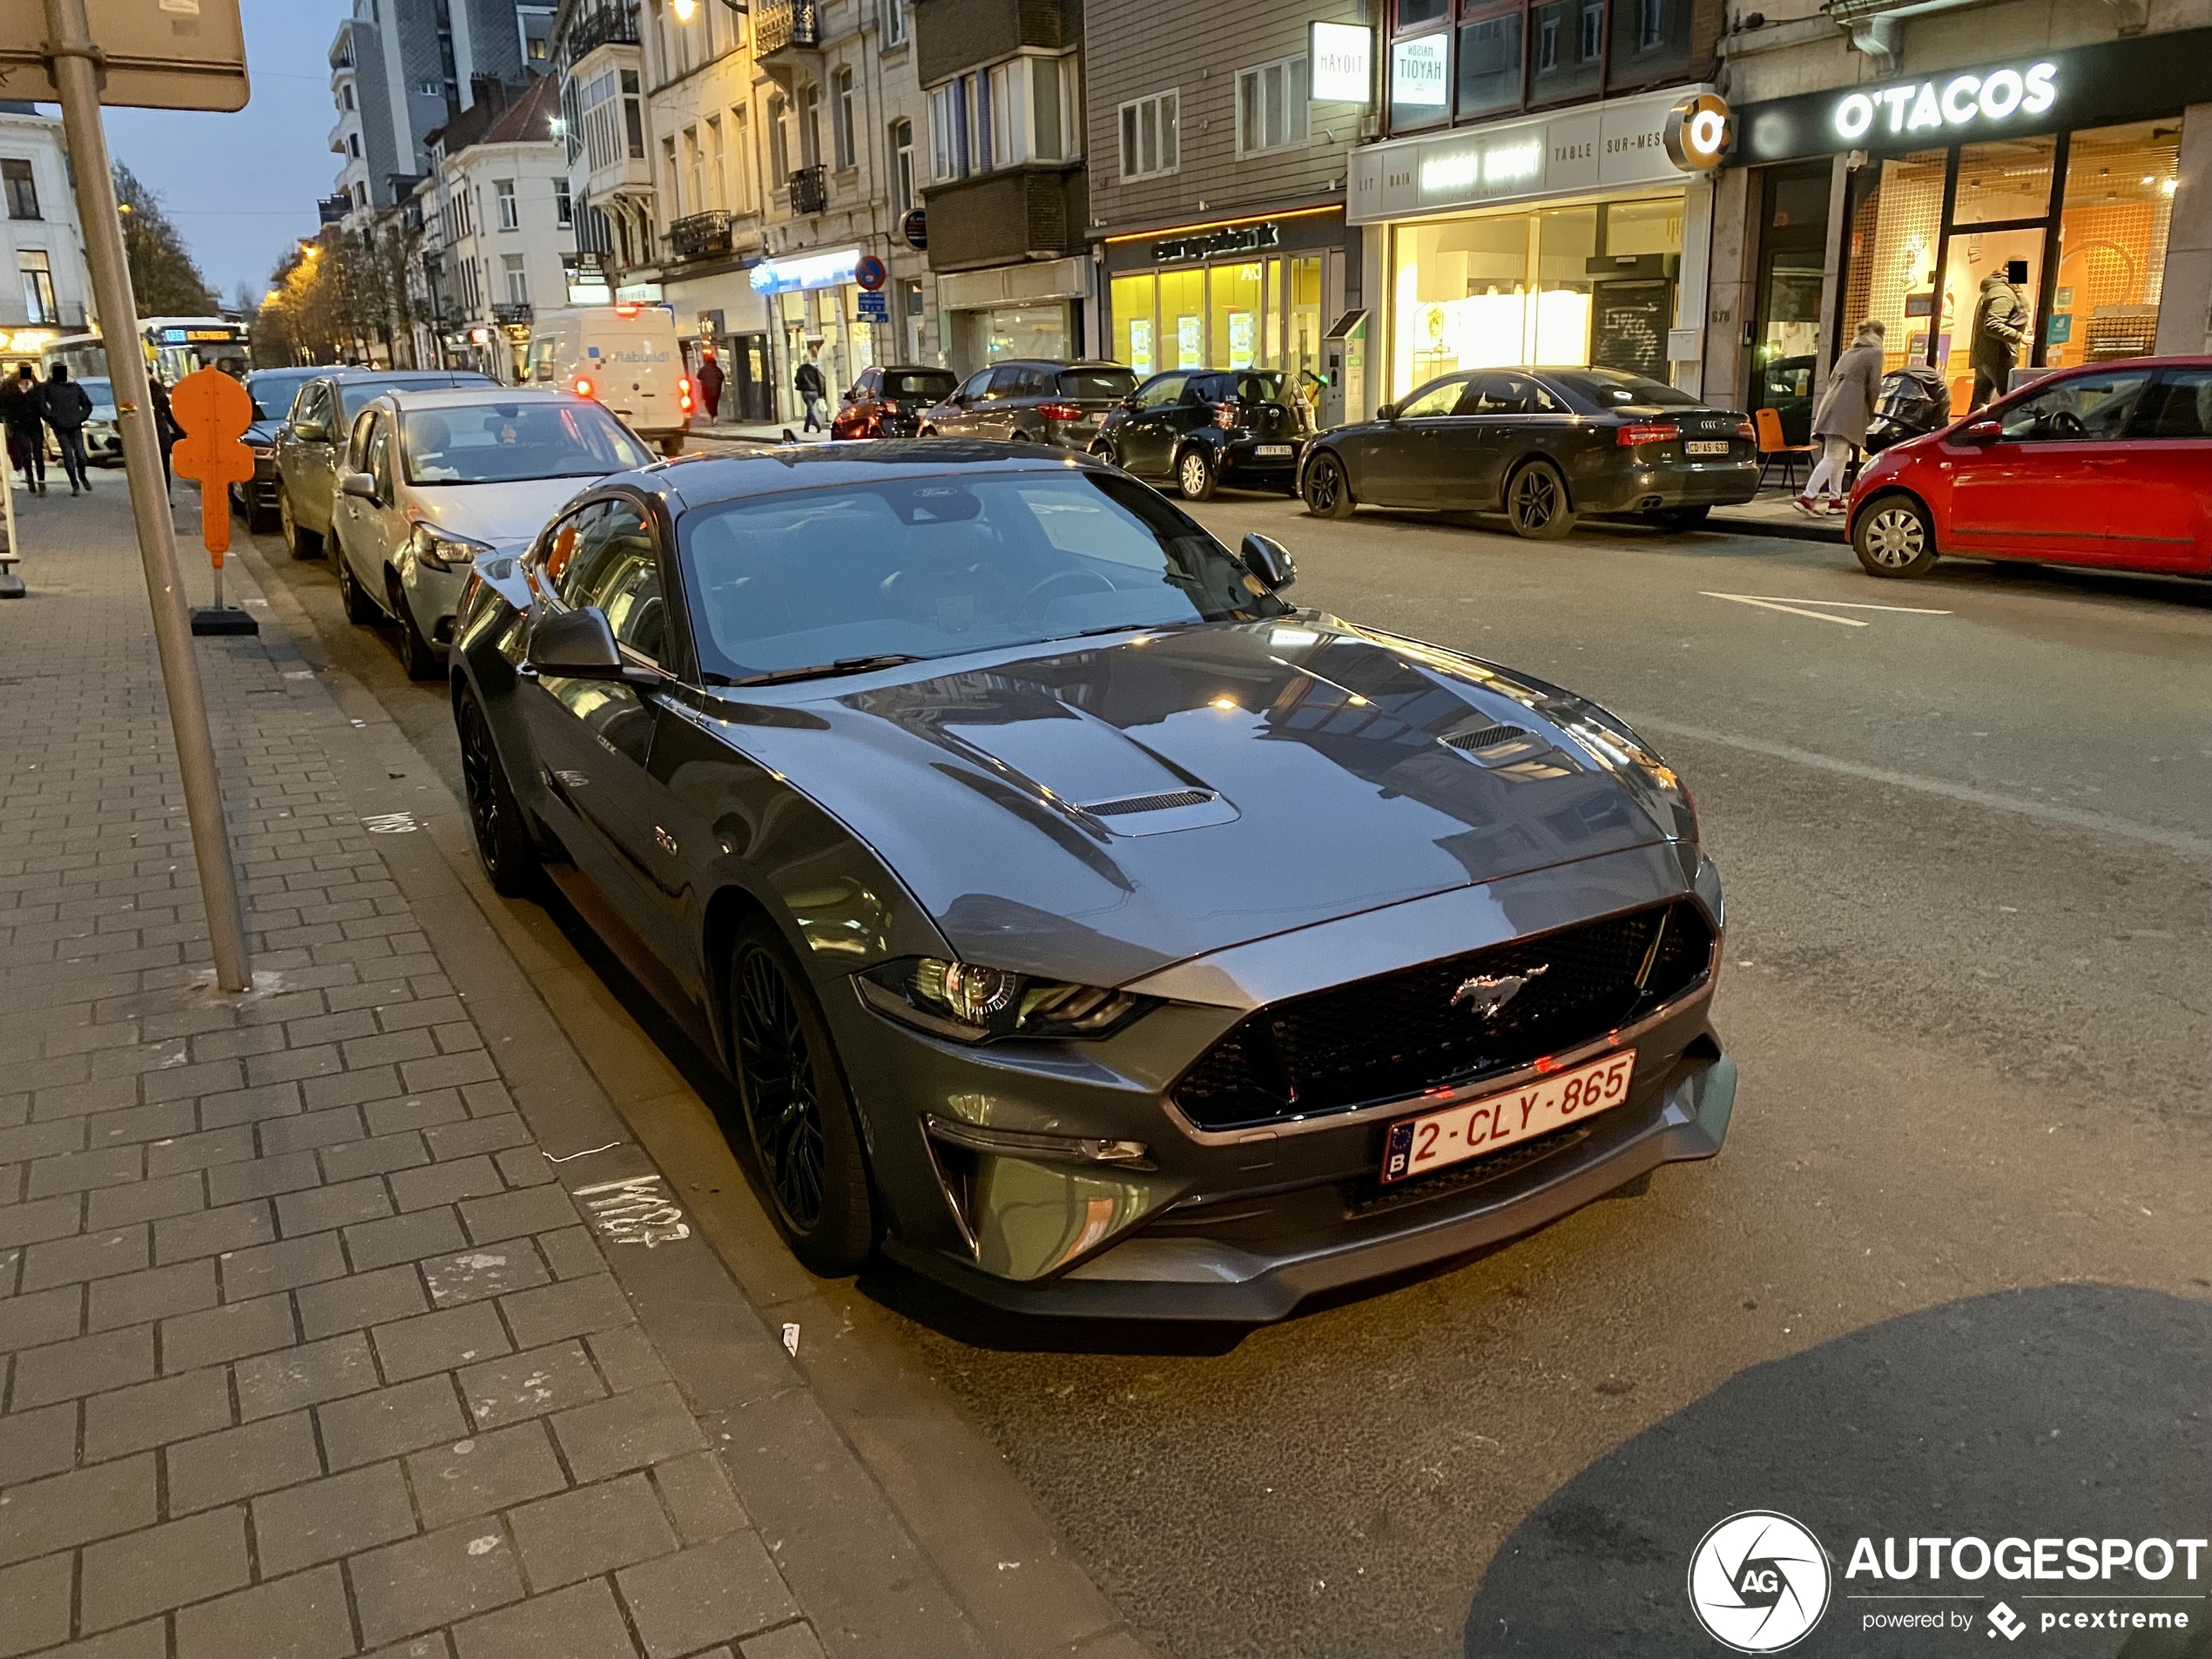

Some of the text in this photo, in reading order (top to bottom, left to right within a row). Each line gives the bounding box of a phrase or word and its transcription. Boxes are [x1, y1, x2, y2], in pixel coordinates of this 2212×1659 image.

[1320, 54, 1363, 74] HAYOIT
[1835, 62, 2058, 138] O'TACOS
[1554, 143, 1592, 162] TABLE
[1607, 132, 1661, 153] SUR-MES
[1359, 178, 1373, 192] LIT
[1390, 172, 1412, 187] BAIN
[1150, 221, 1278, 260] europabank
[167, 331, 182, 341] 136
[1414, 1061, 1629, 1163] 2-CLY-865
[1390, 1153, 1406, 1174] B
